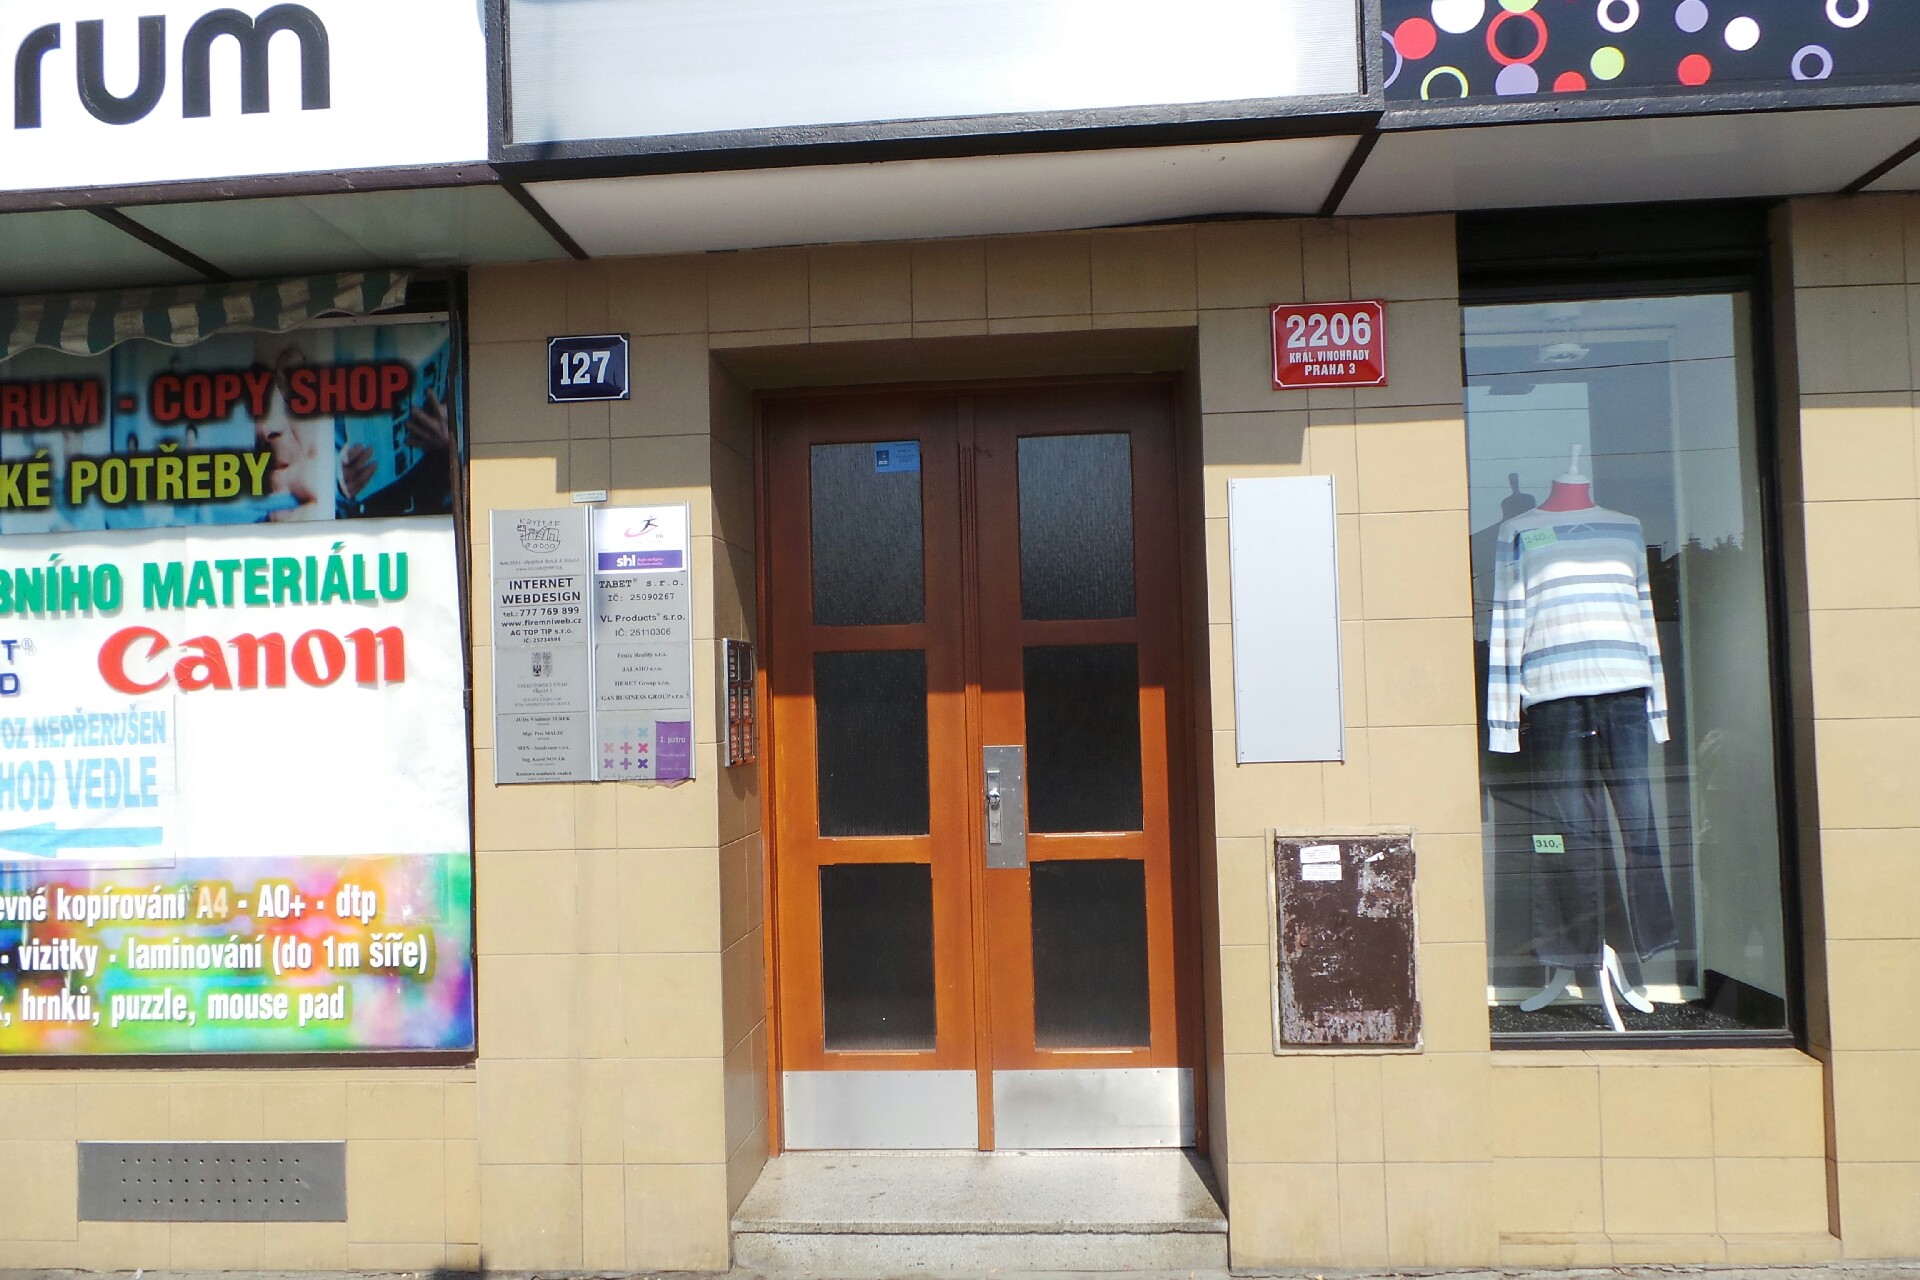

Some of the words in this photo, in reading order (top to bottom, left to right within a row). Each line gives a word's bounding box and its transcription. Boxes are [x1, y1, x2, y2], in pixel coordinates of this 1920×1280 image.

[14, 3, 331, 129] rum
[1286, 312, 1371, 348] 2206
[560, 350, 611, 385] 127
[1317, 349, 1370, 362] VINOHRADY
[1304, 363, 1345, 376] PRAHA
[1348, 362, 1356, 374] 3
[3, 380, 100, 430] RUM
[153, 371, 276, 422] COPY
[290, 365, 409, 414] SHOP
[71, 444, 271, 505] POTŘEBY
[616, 554, 636, 567] shl
[143, 541, 408, 609] MATERIÁLU
[509, 577, 574, 591] INTERNET
[646, 579, 684, 587] s.r.o.
[501, 591, 581, 605] WEBDESIGN
[608, 592, 624, 602] IČ:
[630, 592, 675, 601] 25090267
[501, 618, 582, 628] www.firemniweb.cz
[520, 608, 538, 617] 777
[540, 607, 559, 616] 769
[561, 606, 580, 615] 899
[600, 615, 613, 623] VL
[615, 627, 628, 637] IČ:
[630, 628, 672, 636] 25110306
[98, 625, 405, 695] Canon
[2, 716, 29, 750] OZ
[34, 704, 167, 750] NEPŘERUŠEN
[667, 736, 686, 745] patro
[65, 756, 158, 808] VEDLE
[196, 886, 229, 919] A4
[336, 883, 377, 925] dtp
[18, 937, 99, 977] vizitky
[128, 934, 262, 970] laminování
[272, 935, 312, 976] (do
[323, 935, 360, 968] 1m
[369, 932, 428, 974] šíře)
[22, 984, 100, 1027] hrnků,
[111, 987, 196, 1028] puzzle,
[207, 992, 289, 1020] mouse
[299, 985, 345, 1027] pad
